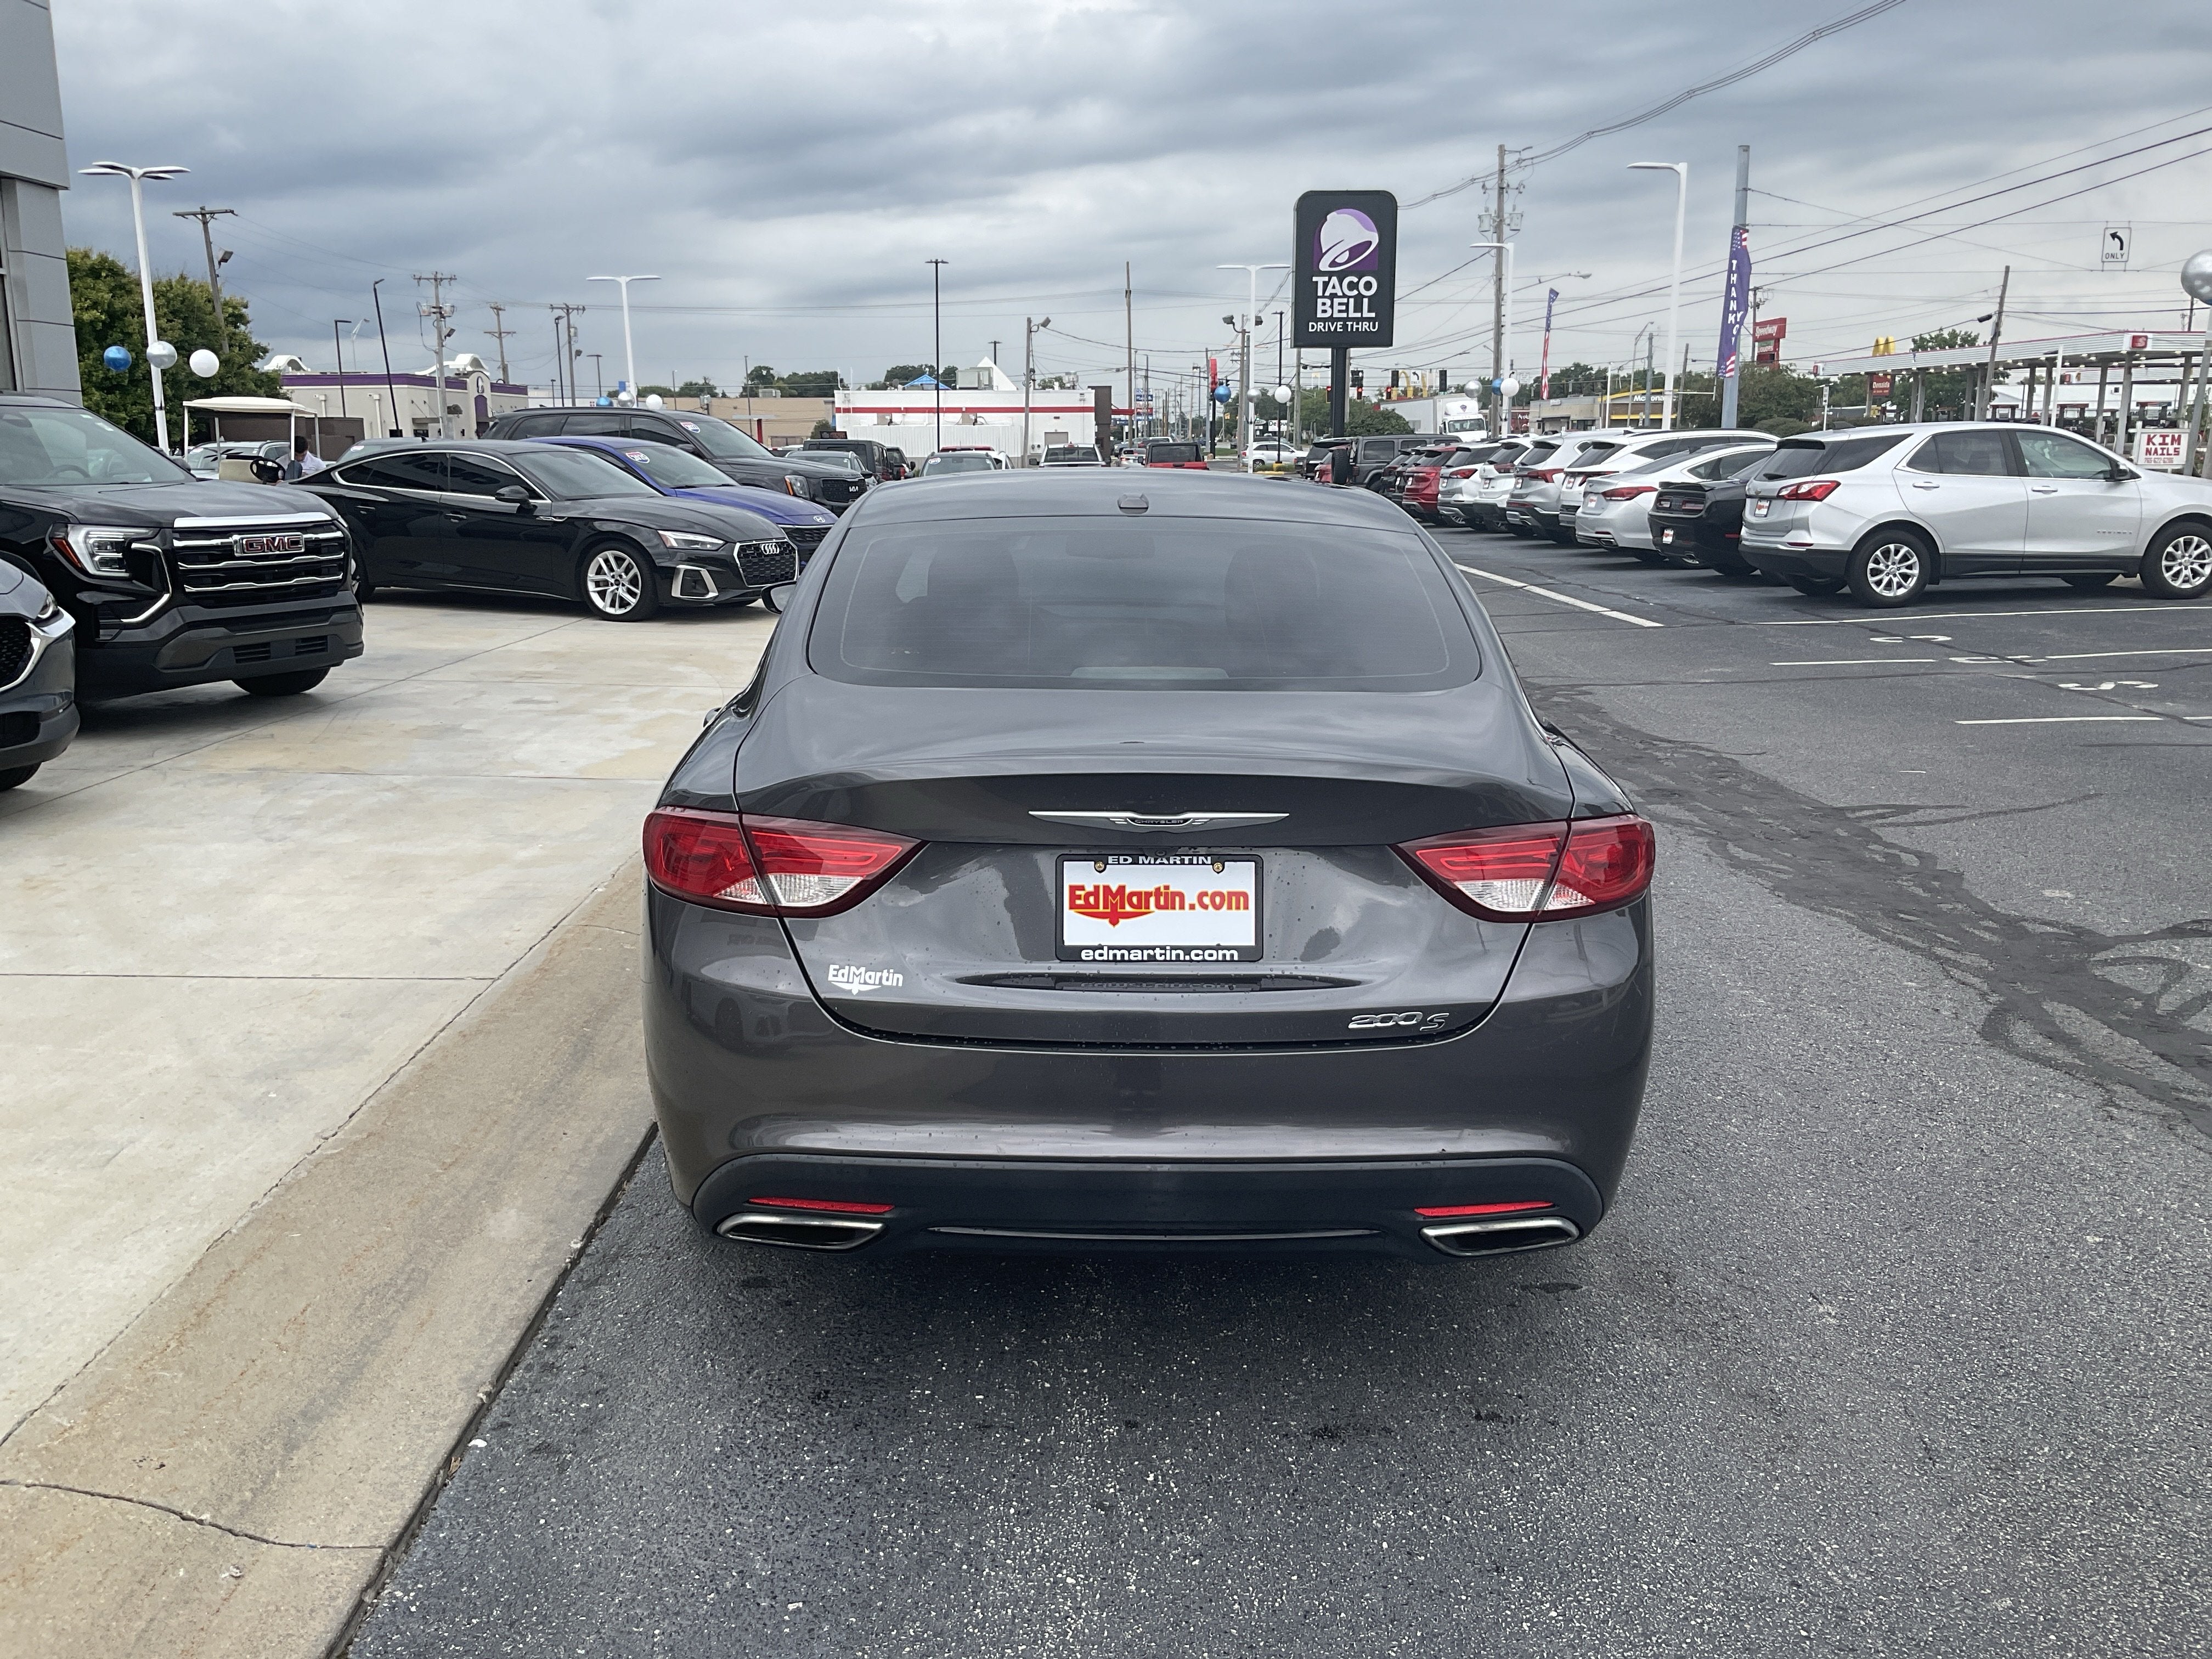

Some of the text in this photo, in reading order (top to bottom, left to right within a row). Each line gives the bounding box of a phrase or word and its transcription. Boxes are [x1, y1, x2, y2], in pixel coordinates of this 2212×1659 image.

[1312, 276, 1378, 296] TACO
[1728, 259, 1737, 324] THANK
[1316, 298, 1375, 318] BELL
[1308, 321, 1378, 332] DRIVE THRU
[1731, 311, 1744, 346] YO
[2146, 434, 2182, 446] KIM
[2145, 447, 2180, 456] NAILS
[243, 537, 303, 553] GMC
[1108, 856, 1211, 865] ED MARTIN
[1068, 884, 1249, 912] EdMartin.com
[1081, 946, 1238, 961] edmartin.com
[828, 964, 904, 987] EdMartin
[1348, 1012, 1449, 1031] 200 S
